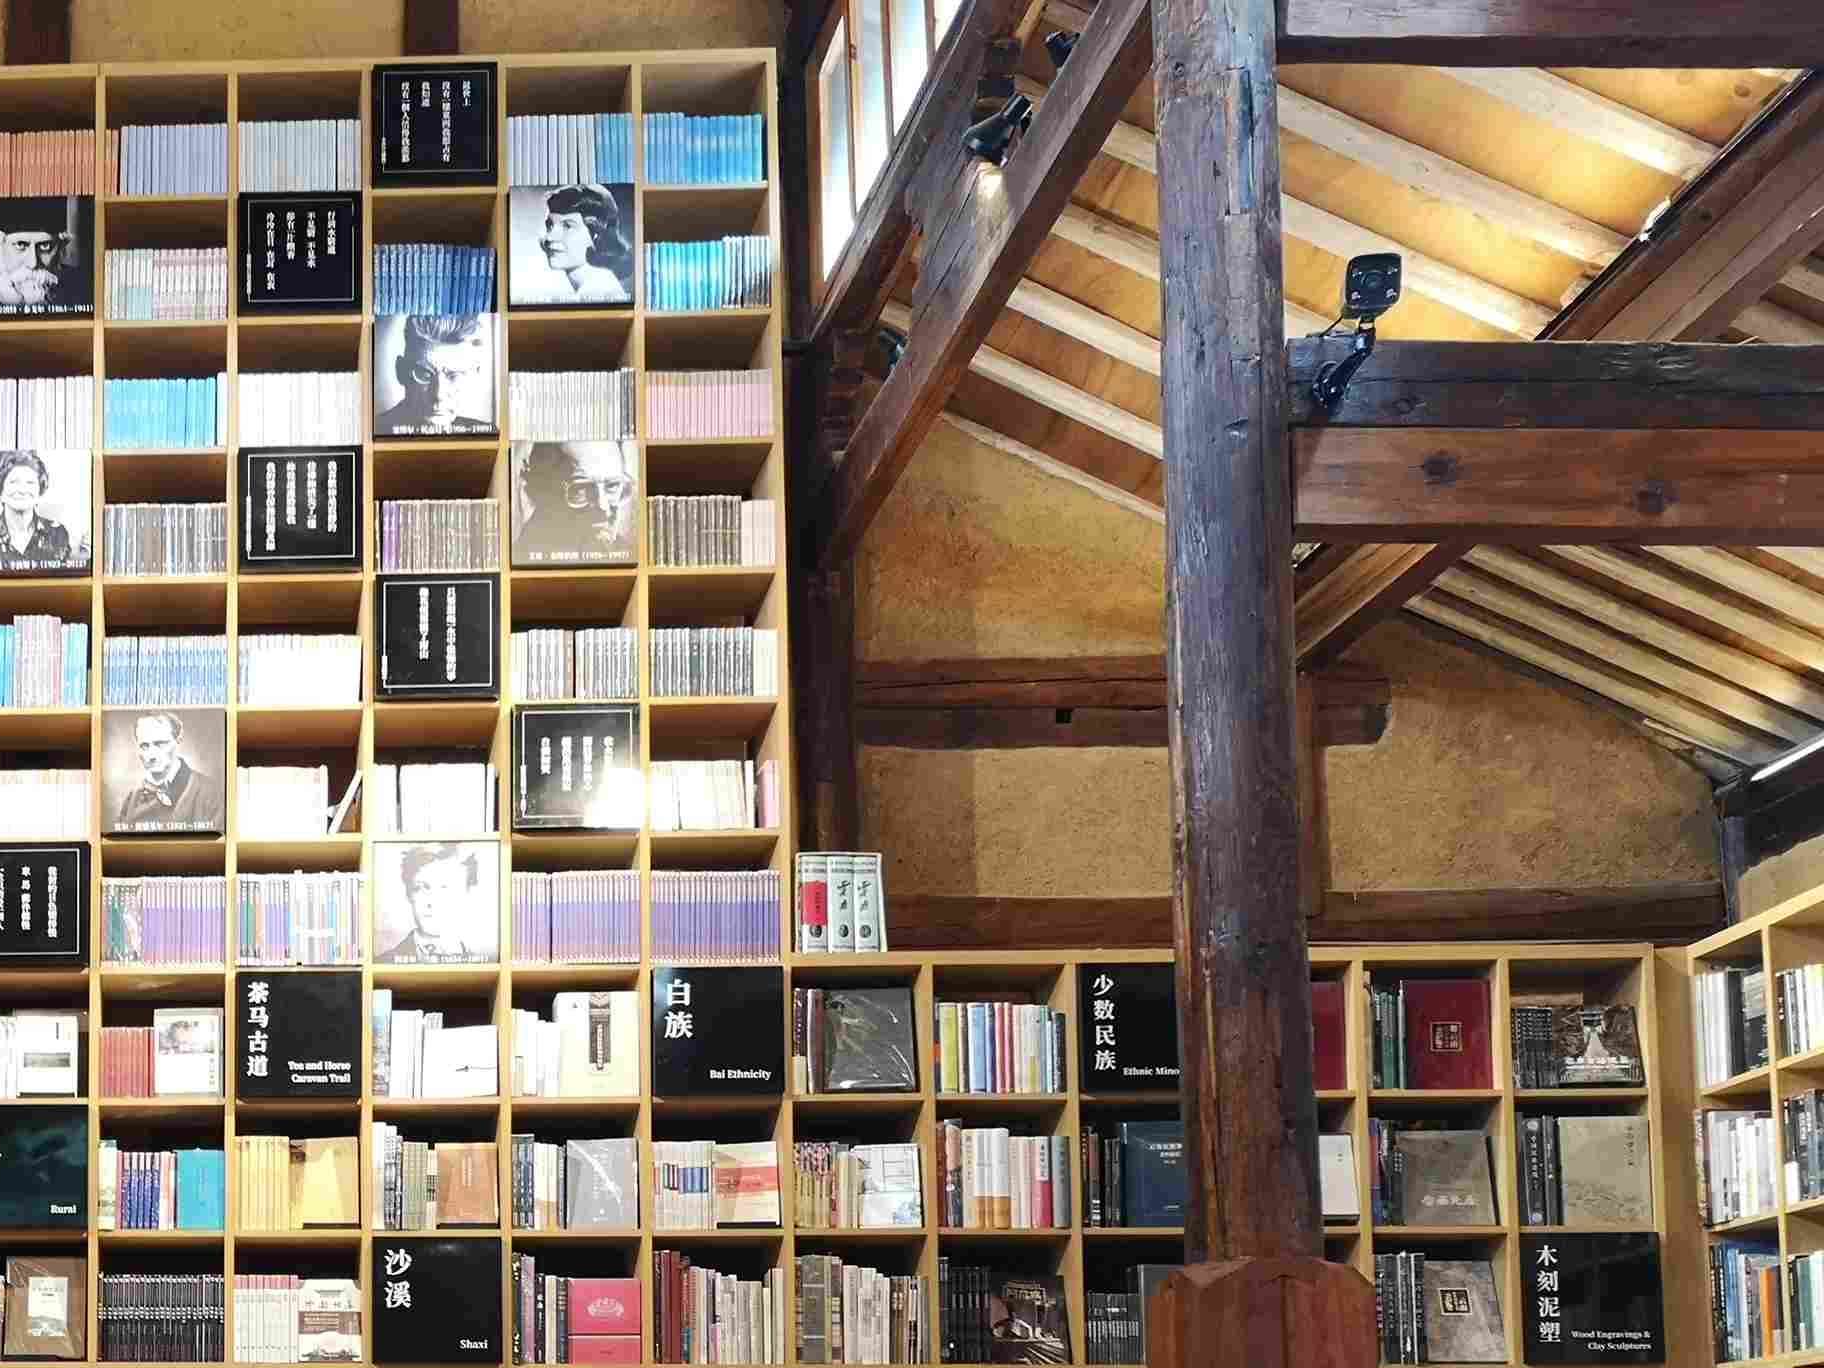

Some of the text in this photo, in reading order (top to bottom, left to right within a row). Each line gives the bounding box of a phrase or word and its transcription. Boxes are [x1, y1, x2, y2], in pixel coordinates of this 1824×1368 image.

[664, 978, 694, 1039] 白族
[1093, 974, 1116, 1071] 少数民族
[246, 981, 270, 1077] 茶马古道
[287, 1060, 352, 1071] Tea and Horse
[1123, 1066, 1153, 1076] Ethnic
[329, 1072, 351, 1083] Trail
[709, 1069, 772, 1083] Bai Ethnicity
[50, 1204, 77, 1214] Rural
[383, 1248, 413, 1309] 沙溪
[1536, 1244, 1561, 1343] 木刻泥塑
[1570, 1330, 1595, 1340] Wood
[459, 1339, 488, 1349] Shaxi
[1587, 1342, 1605, 1353] Clay
